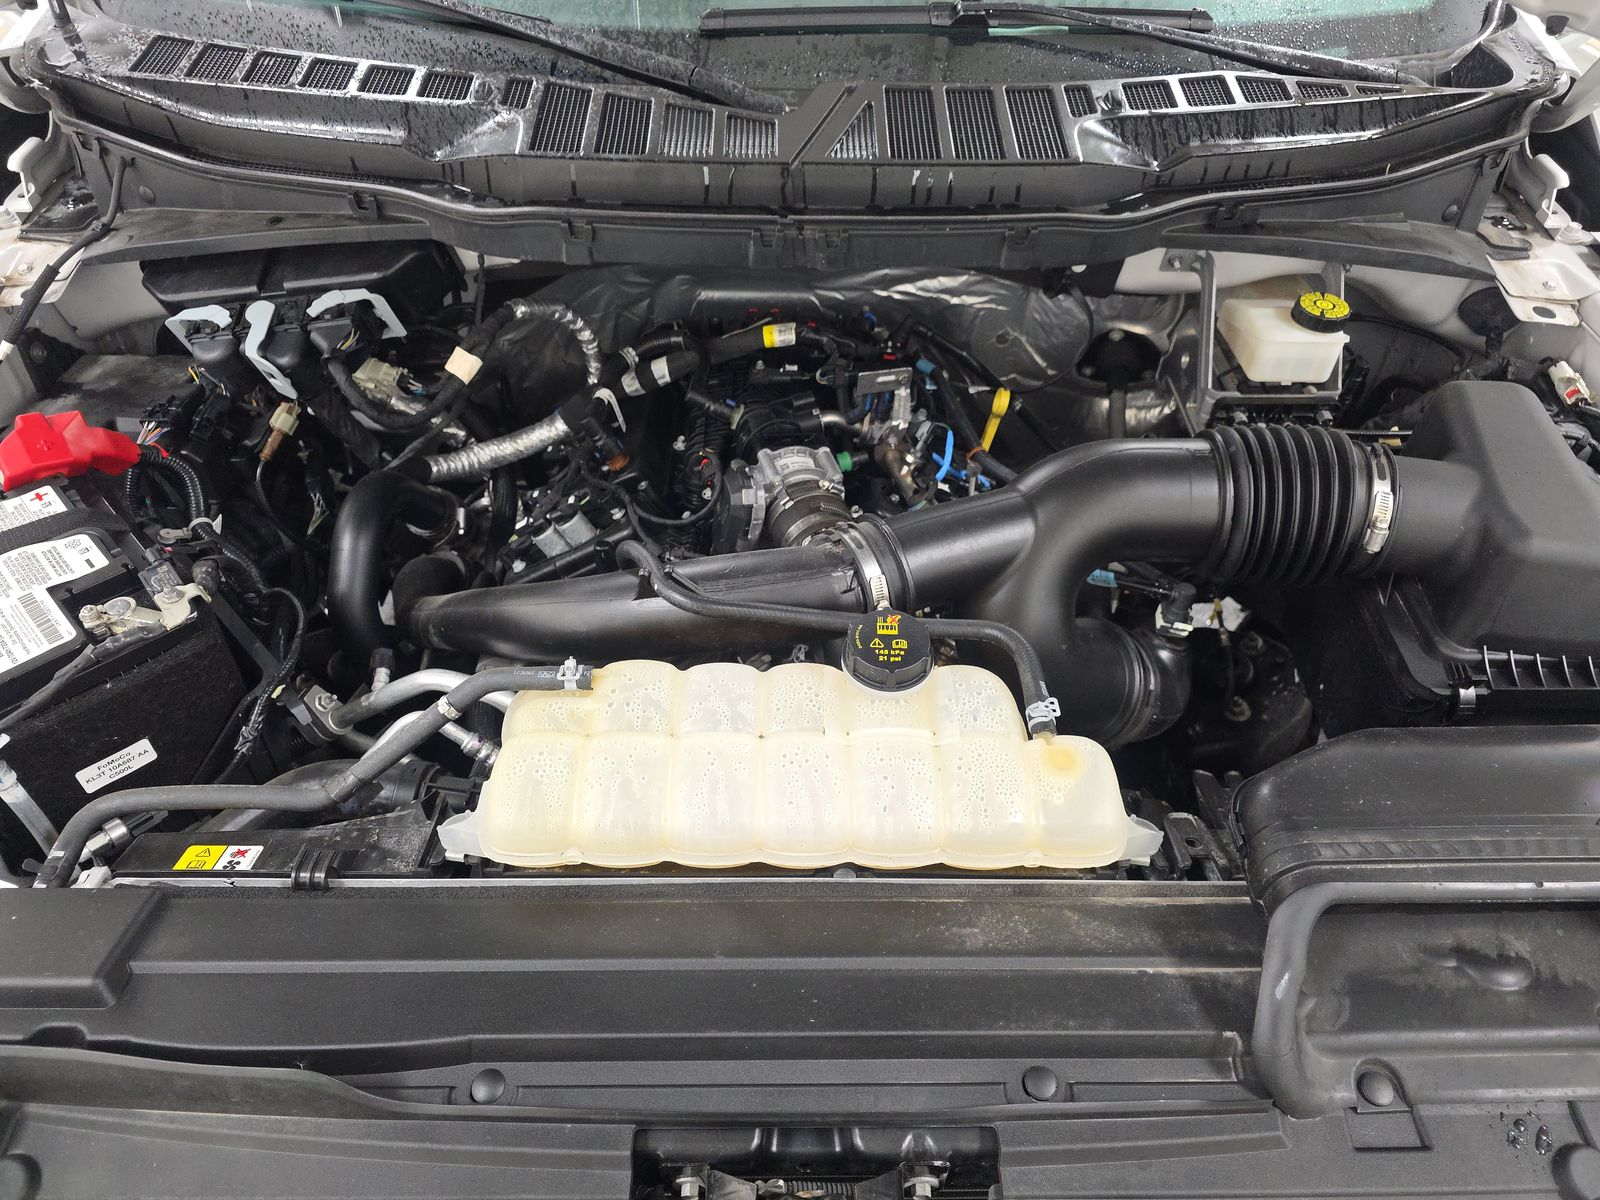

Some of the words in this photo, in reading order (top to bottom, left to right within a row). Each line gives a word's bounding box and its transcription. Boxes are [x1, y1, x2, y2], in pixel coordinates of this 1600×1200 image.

[85, 771, 106, 784] KL3T
[138, 749, 149, 757] AA
[97, 752, 131, 771] FoMoCo
